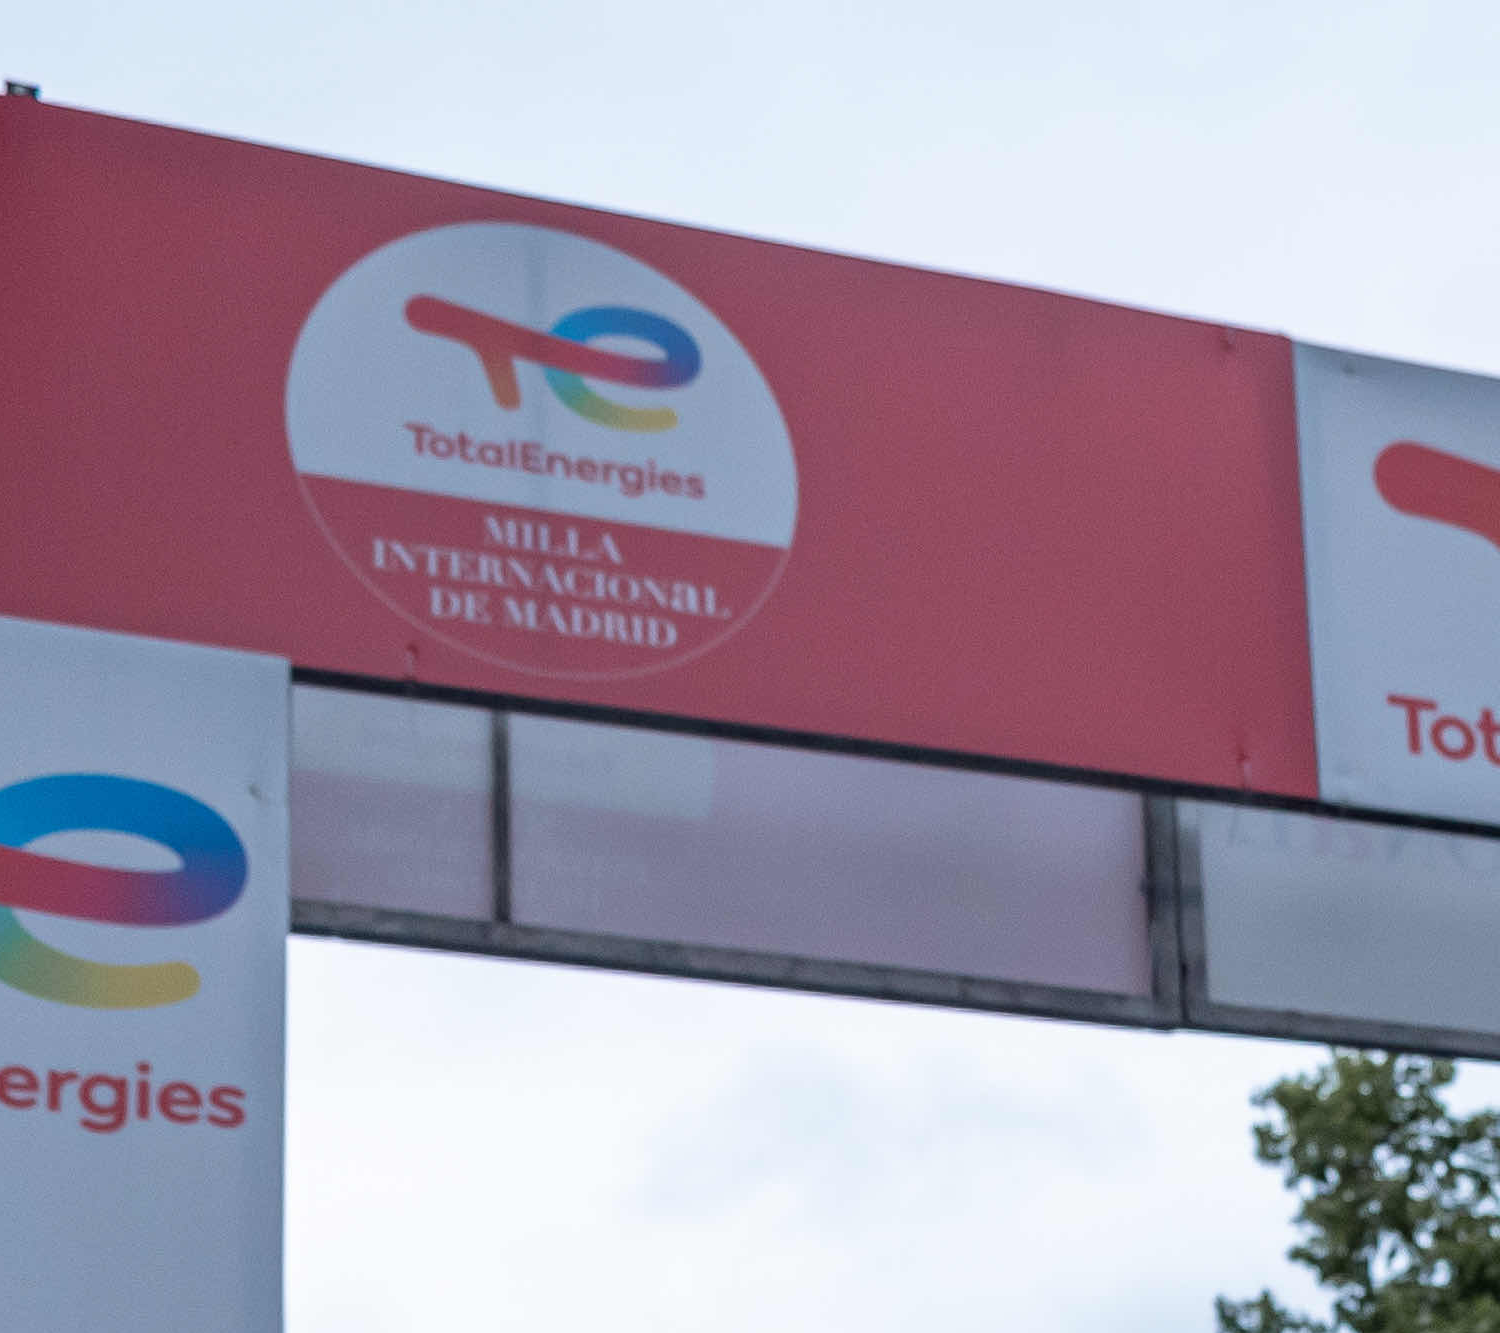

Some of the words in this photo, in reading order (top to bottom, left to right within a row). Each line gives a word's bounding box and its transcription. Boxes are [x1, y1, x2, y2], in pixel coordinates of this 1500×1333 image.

[403, 421, 707, 499] TotalEnergies
[483, 513, 624, 565] MILLA
[428, 585, 493, 625] DE
[500, 594, 679, 650] MADRID
